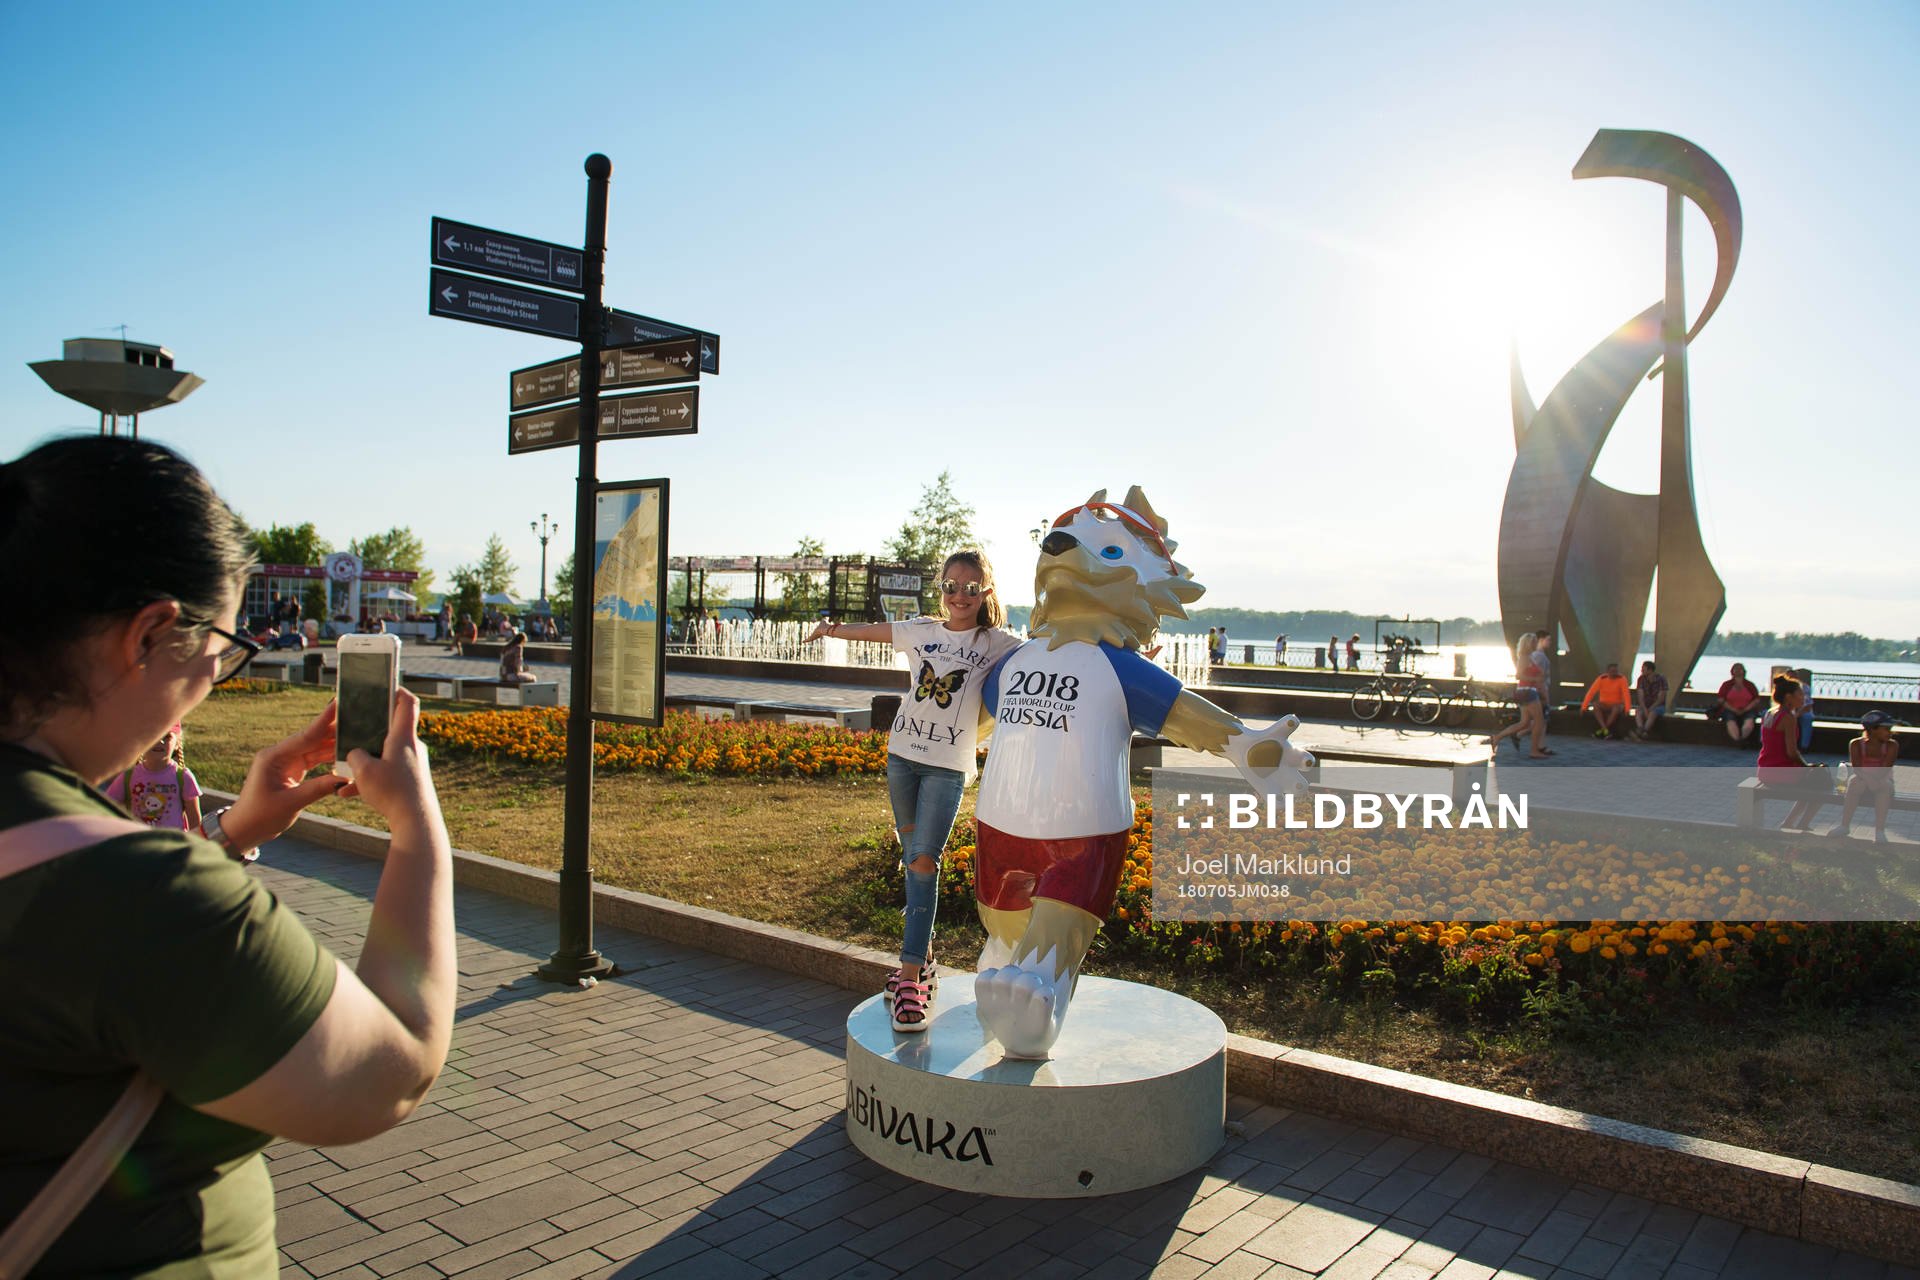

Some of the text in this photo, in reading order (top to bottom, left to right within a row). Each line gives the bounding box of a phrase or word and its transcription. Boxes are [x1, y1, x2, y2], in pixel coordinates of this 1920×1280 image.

[463, 241, 474, 254] 1,1
[467, 300, 539, 321] Leningradskaya Street
[489, 293, 540, 311] Ленинградская
[954, 648, 991, 670] ARE
[1006, 671, 1080, 702] 2018
[1003, 697, 1076, 712] FIFA WORLD CUP
[894, 714, 965, 746] ONLY
[1000, 707, 1069, 733] RUSSIA
